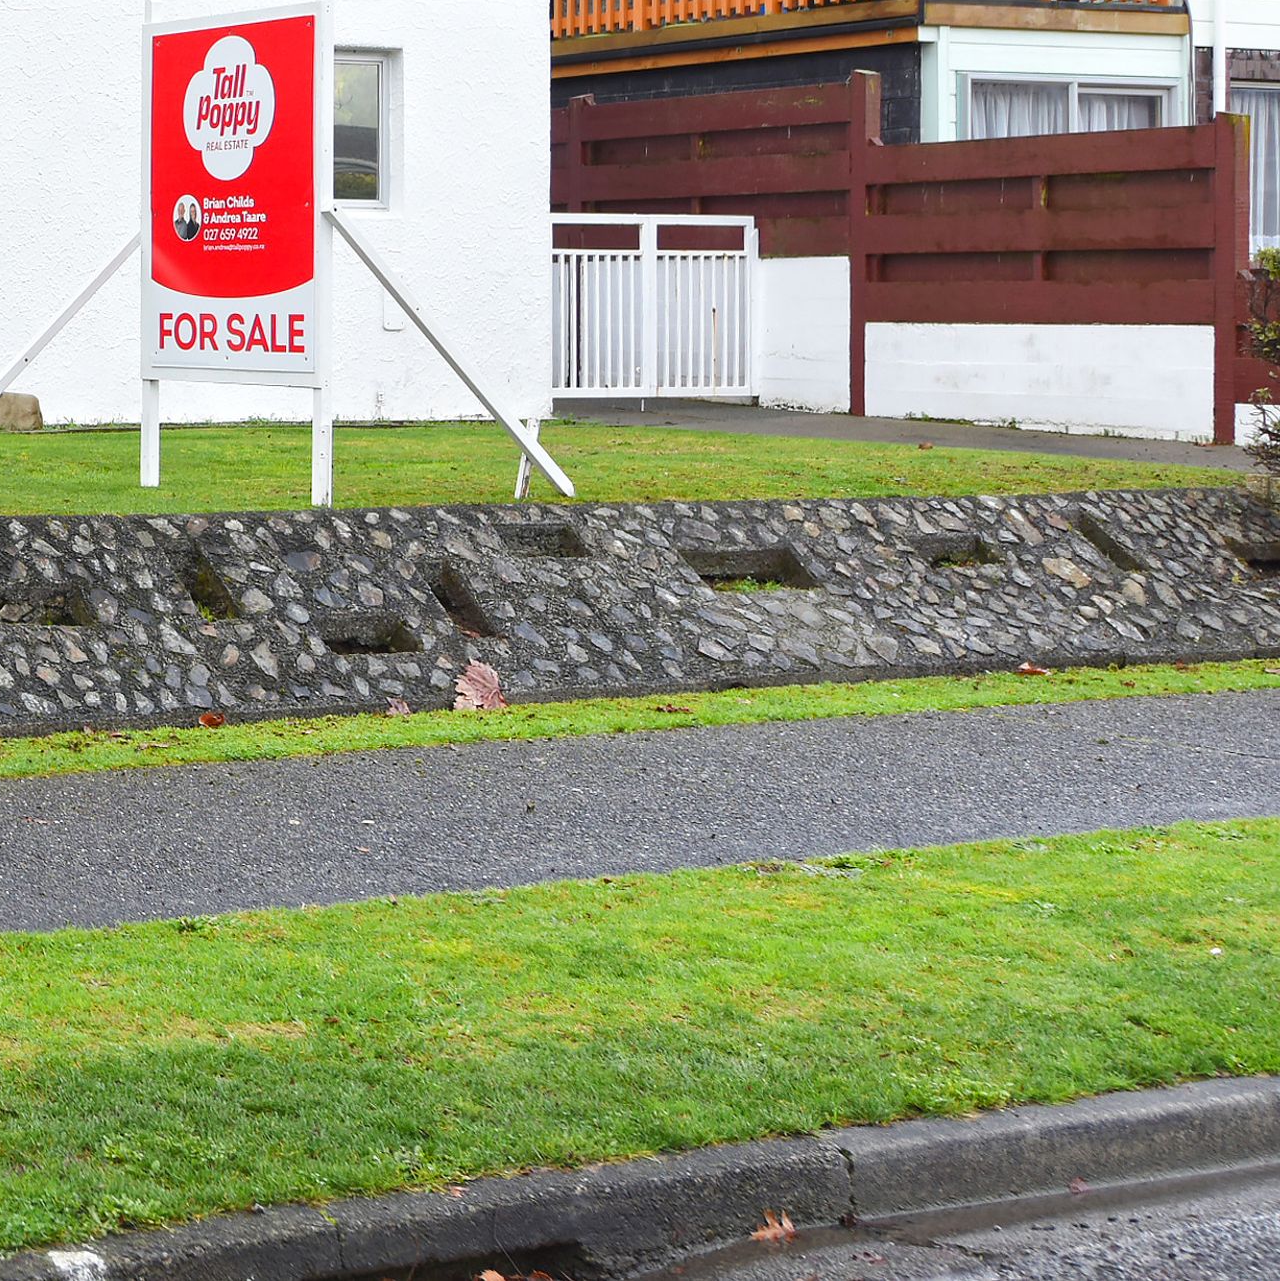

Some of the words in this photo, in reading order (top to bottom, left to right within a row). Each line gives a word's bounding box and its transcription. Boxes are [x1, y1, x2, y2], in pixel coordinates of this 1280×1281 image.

[213, 64, 246, 99] Tall
[206, 141, 223, 151] REAL
[224, 139, 249, 150] ESTATE
[203, 197, 226, 209] Brian
[226, 195, 255, 208] Childs
[203, 212, 210, 224] &
[210, 211, 241, 223] Andrea
[241, 210, 267, 222] Taare
[203, 228, 219, 240] 027
[220, 228, 236, 240] 659
[237, 227, 259, 239] 4922
[159, 312, 219, 351] FOR
[226, 313, 305, 353] SALE
